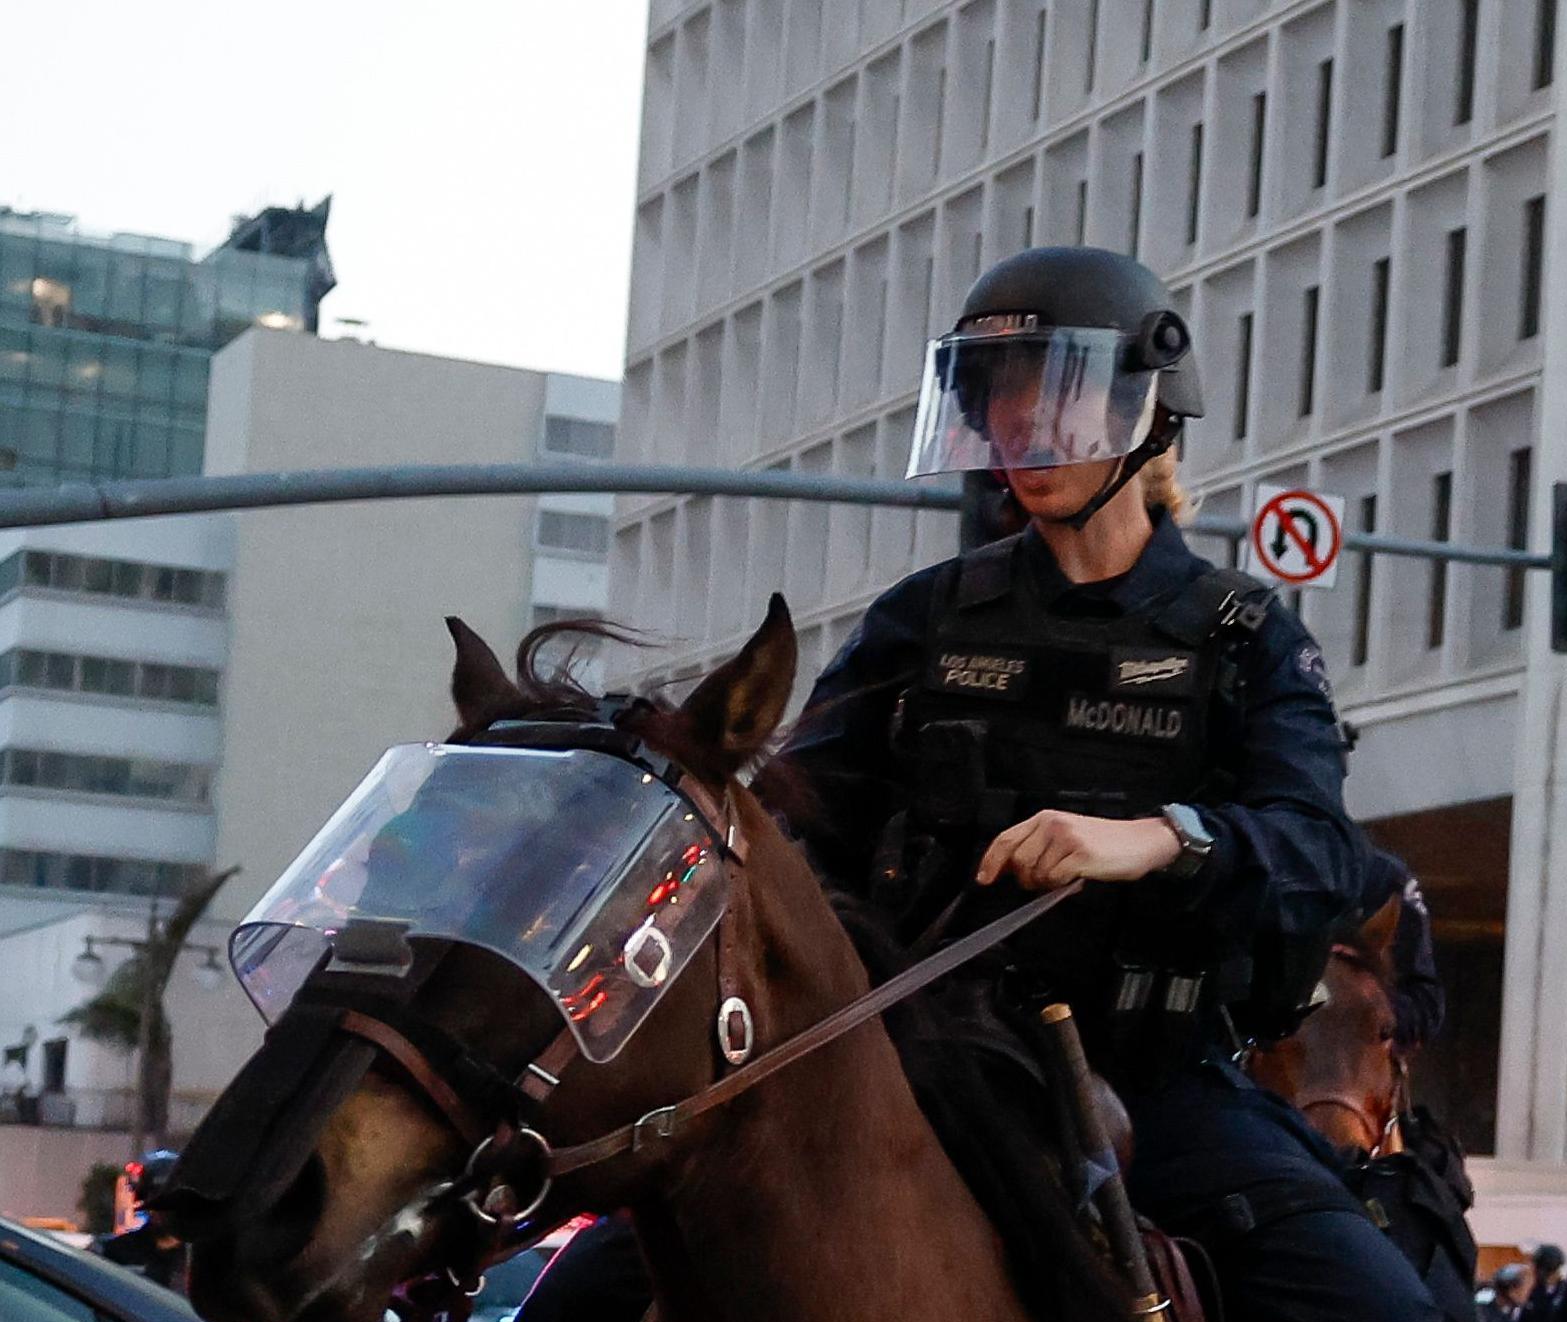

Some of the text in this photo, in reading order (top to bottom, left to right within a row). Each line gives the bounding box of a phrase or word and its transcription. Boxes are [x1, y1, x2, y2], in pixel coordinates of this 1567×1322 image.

[940, 654, 968, 669] LOS
[945, 669, 1010, 690] POLICE
[1067, 698, 1182, 738] McDONALD
